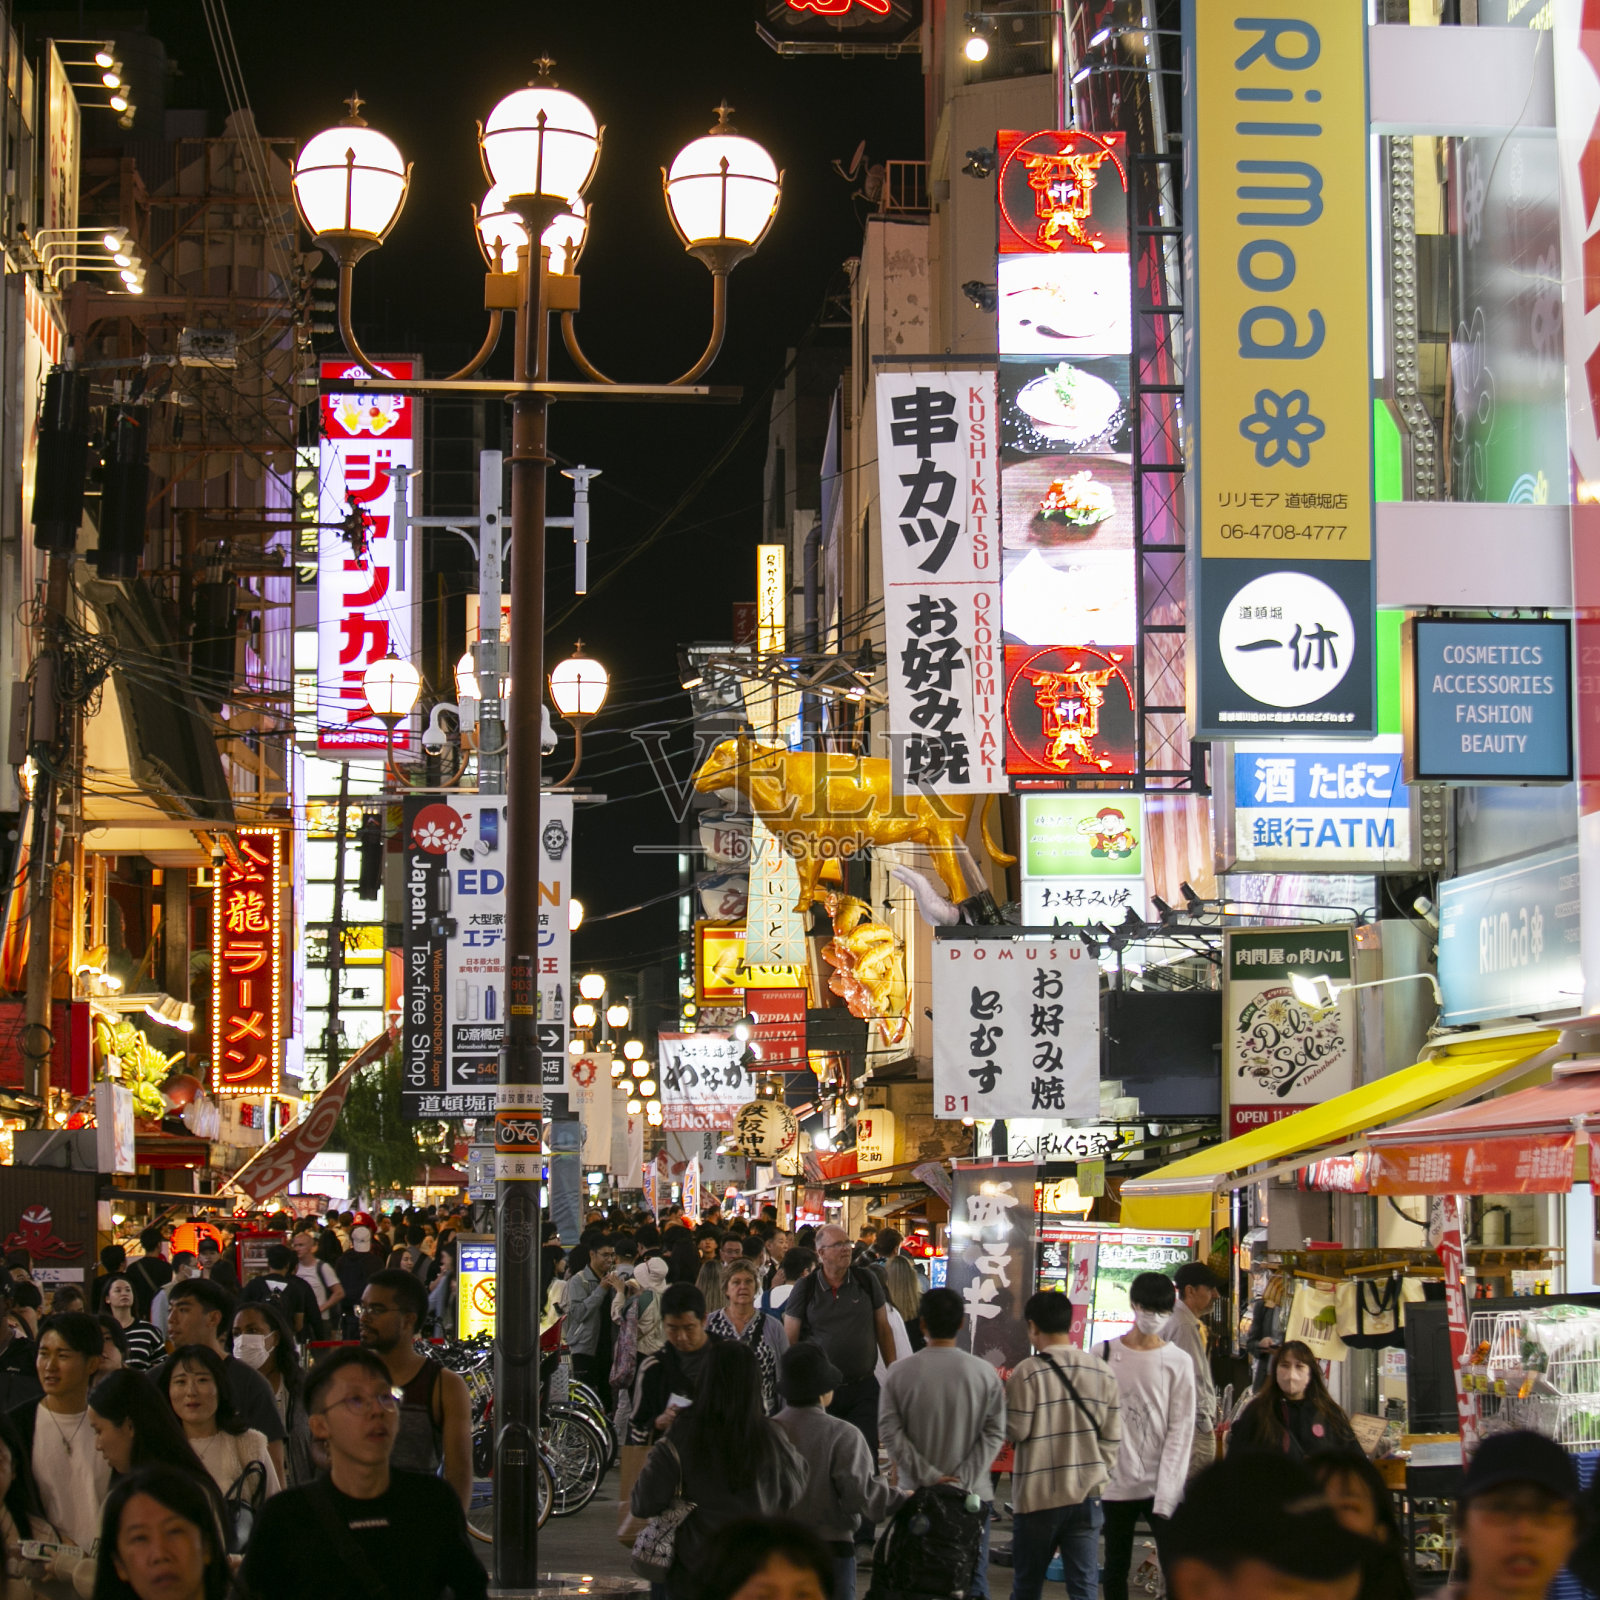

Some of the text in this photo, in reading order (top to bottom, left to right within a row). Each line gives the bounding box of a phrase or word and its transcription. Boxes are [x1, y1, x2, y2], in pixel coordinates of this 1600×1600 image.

[890, 386, 960, 574] 串カツ
[968, 386, 989, 570] KUSHIKATSU
[1219, 492, 1348, 509] リリモア 道頓堀店
[1220, 524, 1347, 540] 06-4708-4777
[1235, 622, 1338, 671] 一休
[1443, 645, 1543, 665] COSMETICS
[900, 594, 970, 785] お好み焼
[973, 592, 997, 783] OKONOMIYAKI
[1432, 675, 1554, 694] ACCESSORIES
[1456, 705, 1533, 723] FASHION
[1461, 735, 1527, 753] BEAUTY
[1254, 757, 1392, 803] 酒 たばこ
[1252, 817, 1395, 848] 銀行ATM
[457, 869, 561, 907] EDN
[1041, 888, 1132, 908] お好み焼
[462, 929, 555, 947] エデン
[223, 839, 270, 1083] 金龍ラーメン
[950, 948, 1081, 960] DOMUSU
[1236, 948, 1344, 965] 肉問屋の肉バル
[408, 855, 431, 1087] Japan. Tax-free Shop
[757, 1012, 803, 1024] EPPAN
[968, 985, 1004, 1095] どむす
[1030, 967, 1065, 1110] お好み焼
[1252, 1009, 1306, 1053] Del
[663, 1055, 754, 1092] わなか
[945, 1095, 969, 1112] B1
[1236, 1111, 1268, 1124] OPEN
[1036, 1132, 1109, 1156] ぼんくら家
[500, 1163, 540, 1174] 大阪市
[857, 1153, 882, 1162] 之助
